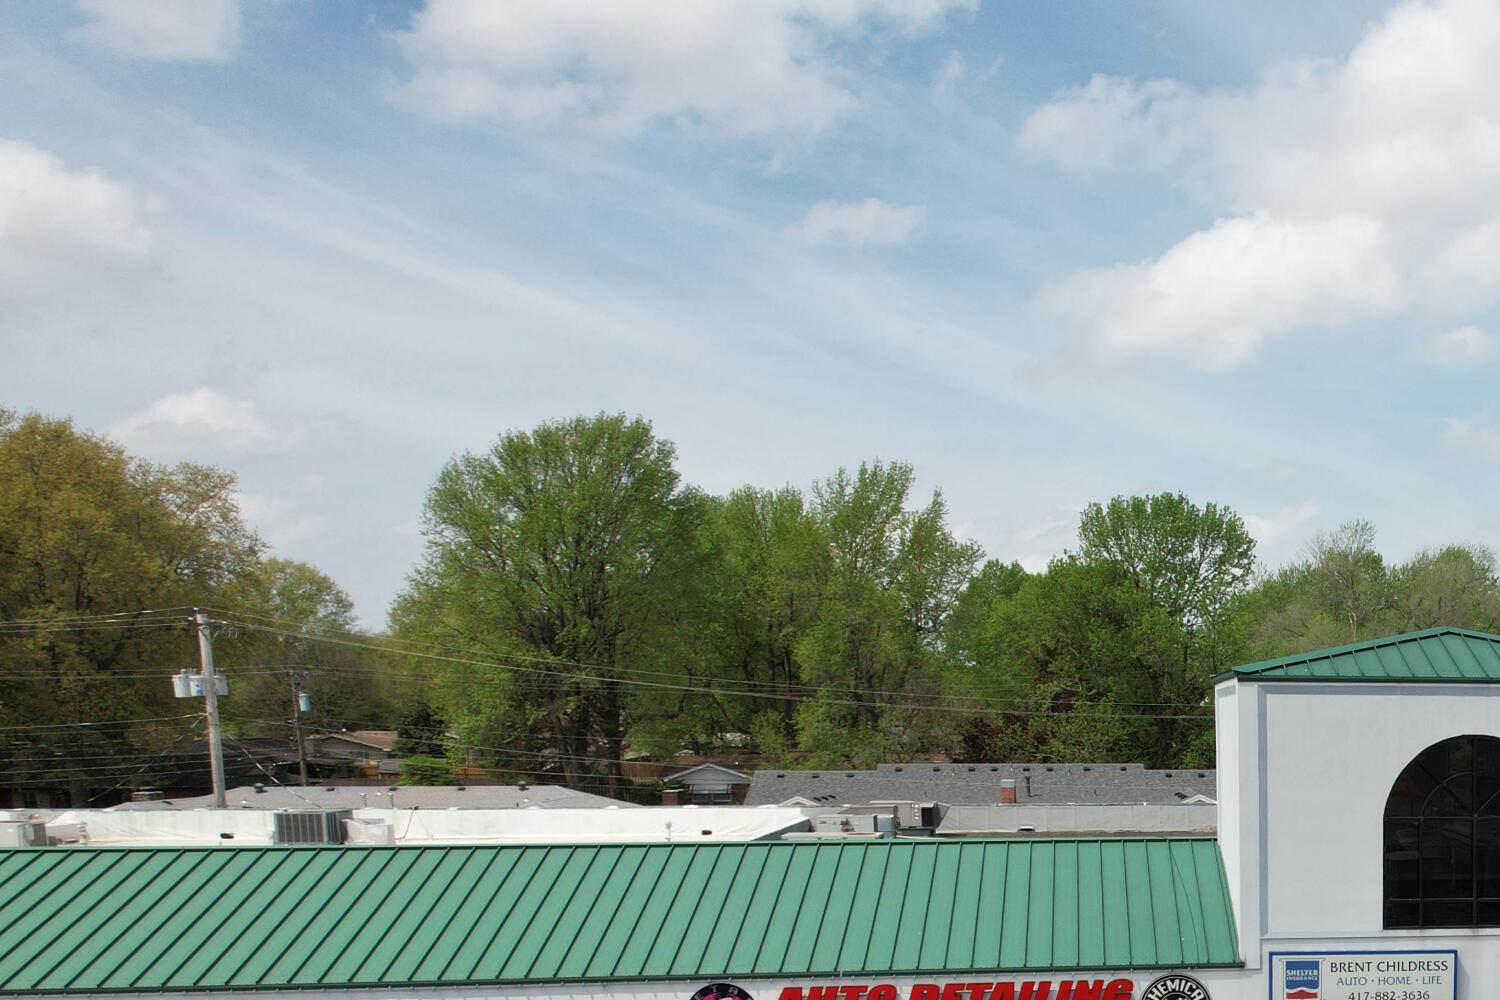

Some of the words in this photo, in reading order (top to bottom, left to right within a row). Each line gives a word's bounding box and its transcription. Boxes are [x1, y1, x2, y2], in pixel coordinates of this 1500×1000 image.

[1330, 961, 1373, 973] BRENT
[1377, 960, 1449, 973] CHILDRESS
[1336, 976, 1368, 986] AUTO
[1378, 976, 1412, 985] HOME
[1422, 975, 1442, 985] LIFE
